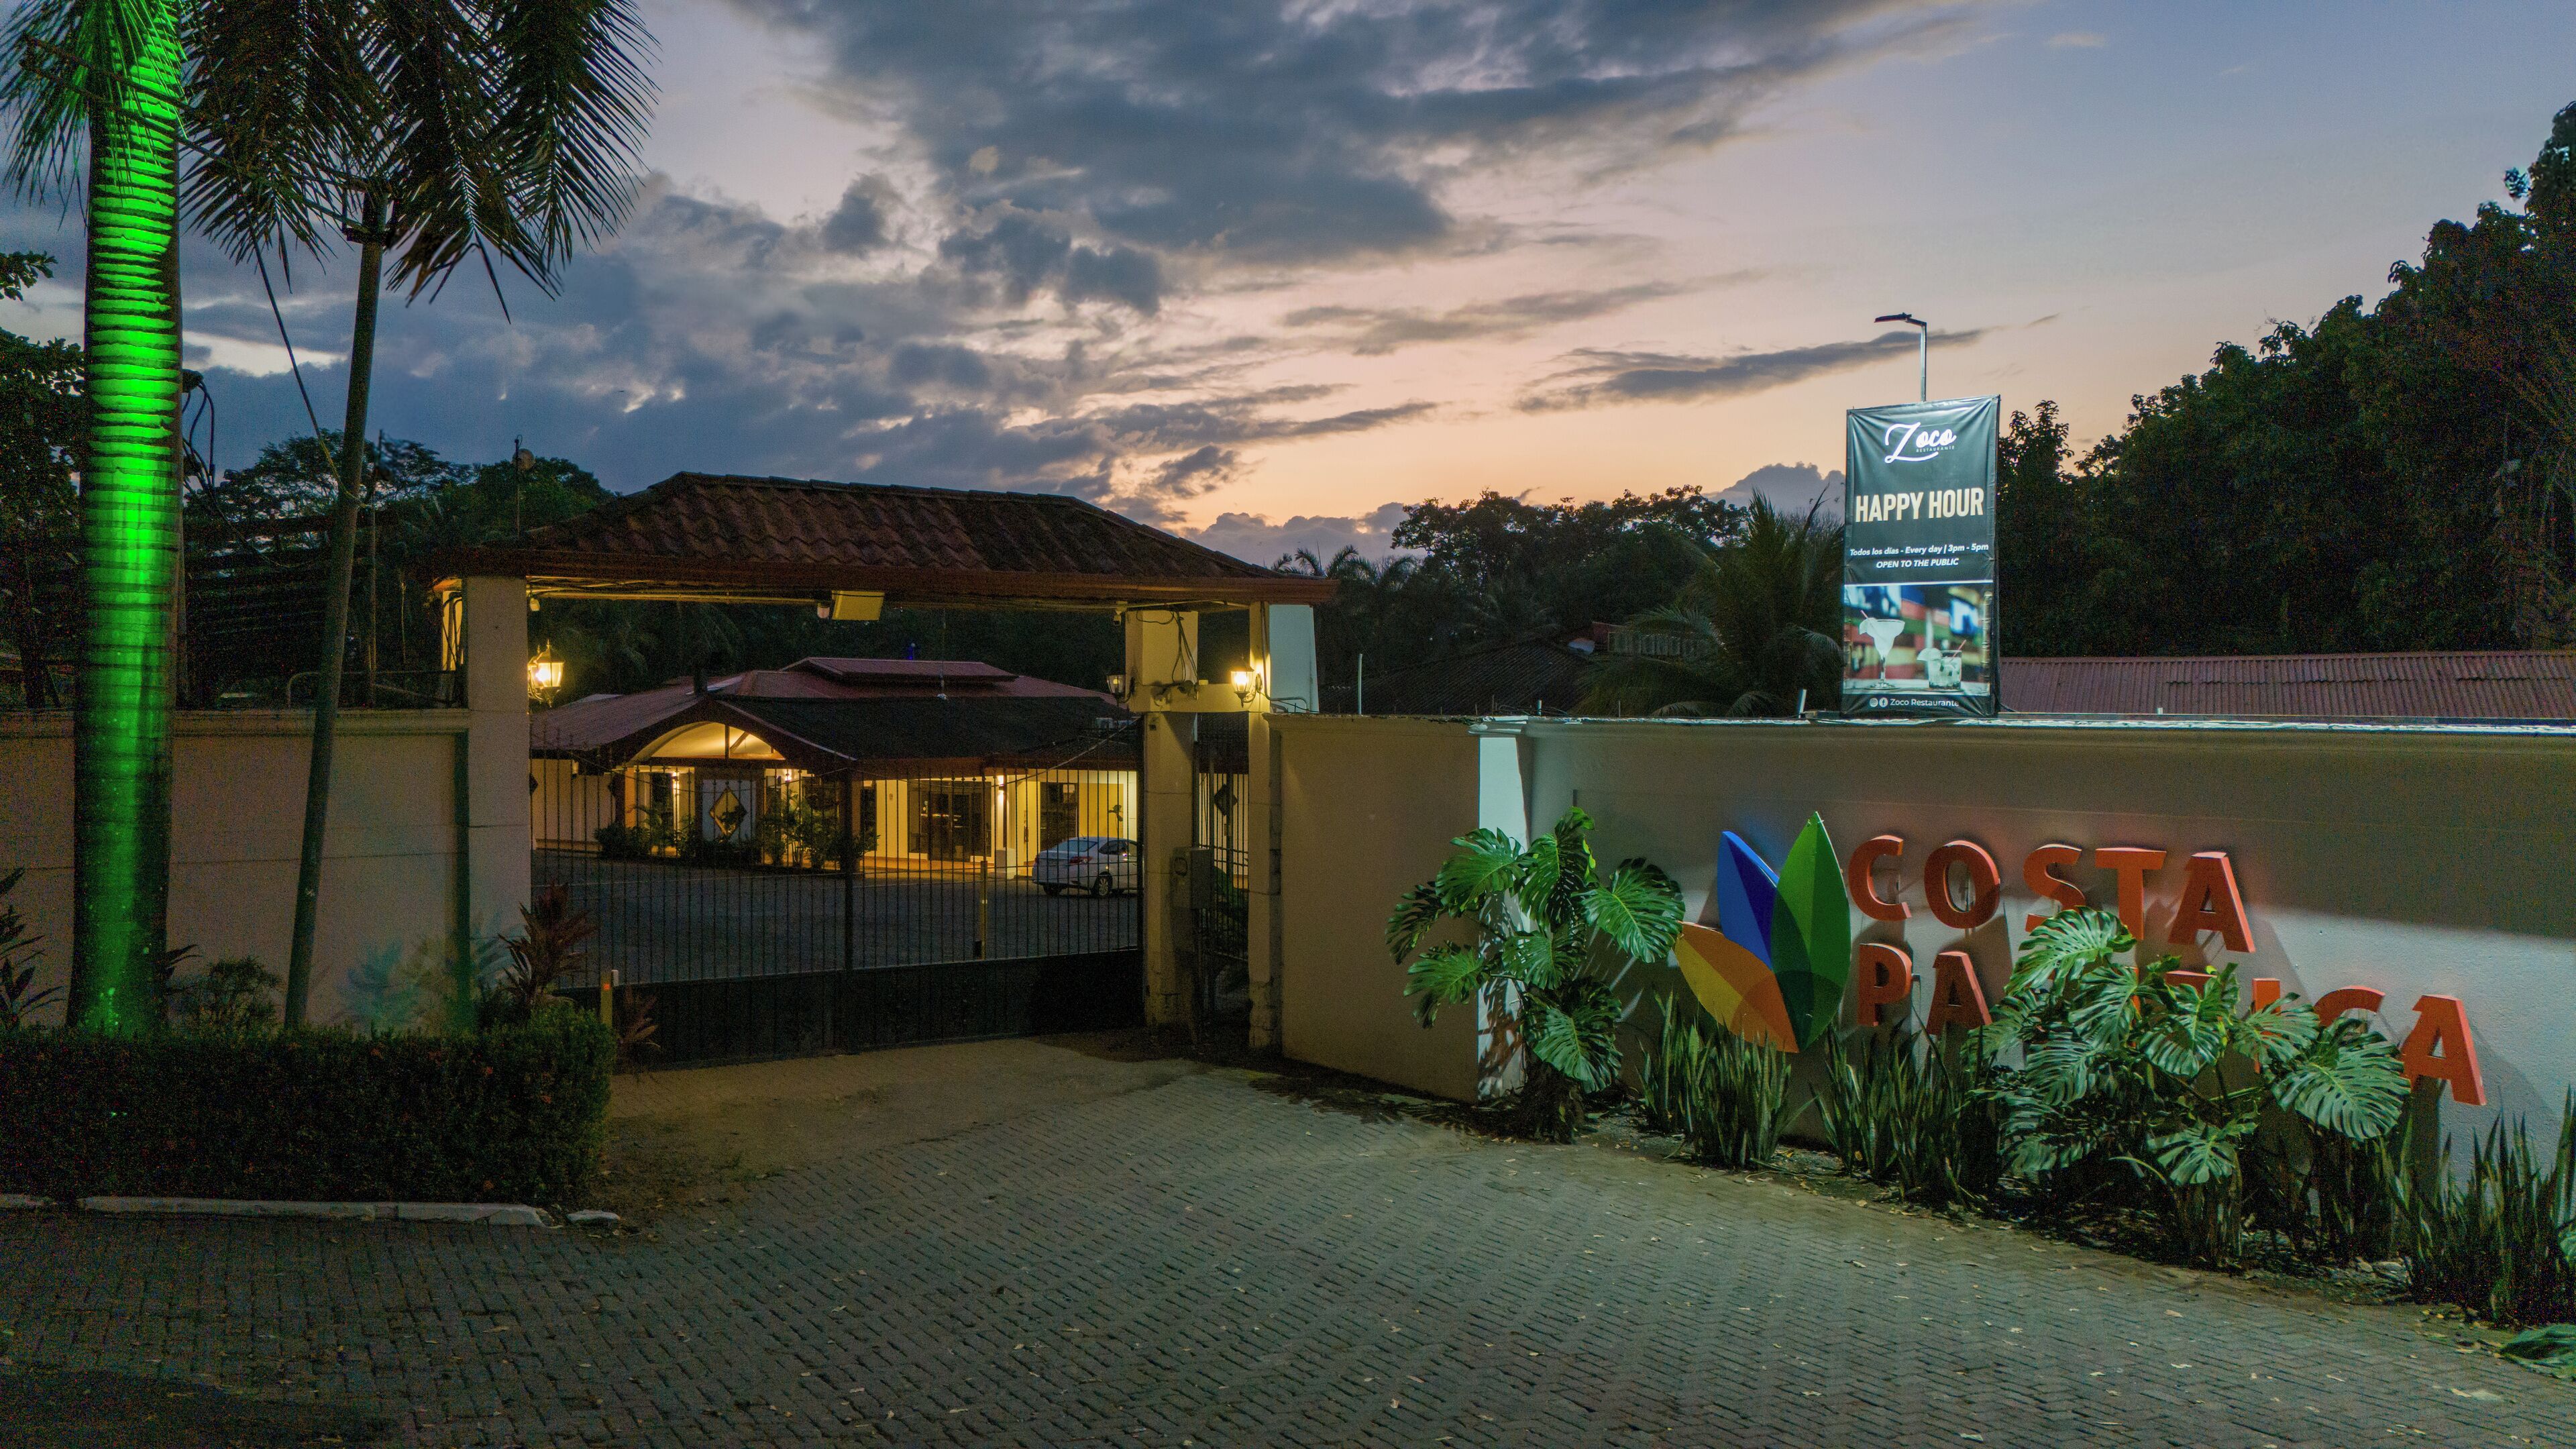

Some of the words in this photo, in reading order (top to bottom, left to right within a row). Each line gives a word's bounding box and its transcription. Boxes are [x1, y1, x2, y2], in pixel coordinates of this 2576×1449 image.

[1884, 421, 1957, 464] Zoco
[1856, 492, 1924, 523] HAPPY
[1929, 488, 1984, 519] HOUR
[1876, 560, 1898, 568] OPEN
[1900, 559, 1912, 568] TO
[1913, 559, 1929, 567] THE
[1931, 557, 1959, 566] PUBLIC
[1884, 547, 1899, 555] días
[1905, 546, 1927, 555] Every
[1928, 544, 1942, 554] day
[1948, 544, 1965, 552] 3pm
[1971, 543, 1989, 551] 5pm
[1911, 698, 1959, 707] Restaurante
[1848, 835, 2256, 953] COSTA
[1857, 943, 2487, 1106] PACA
